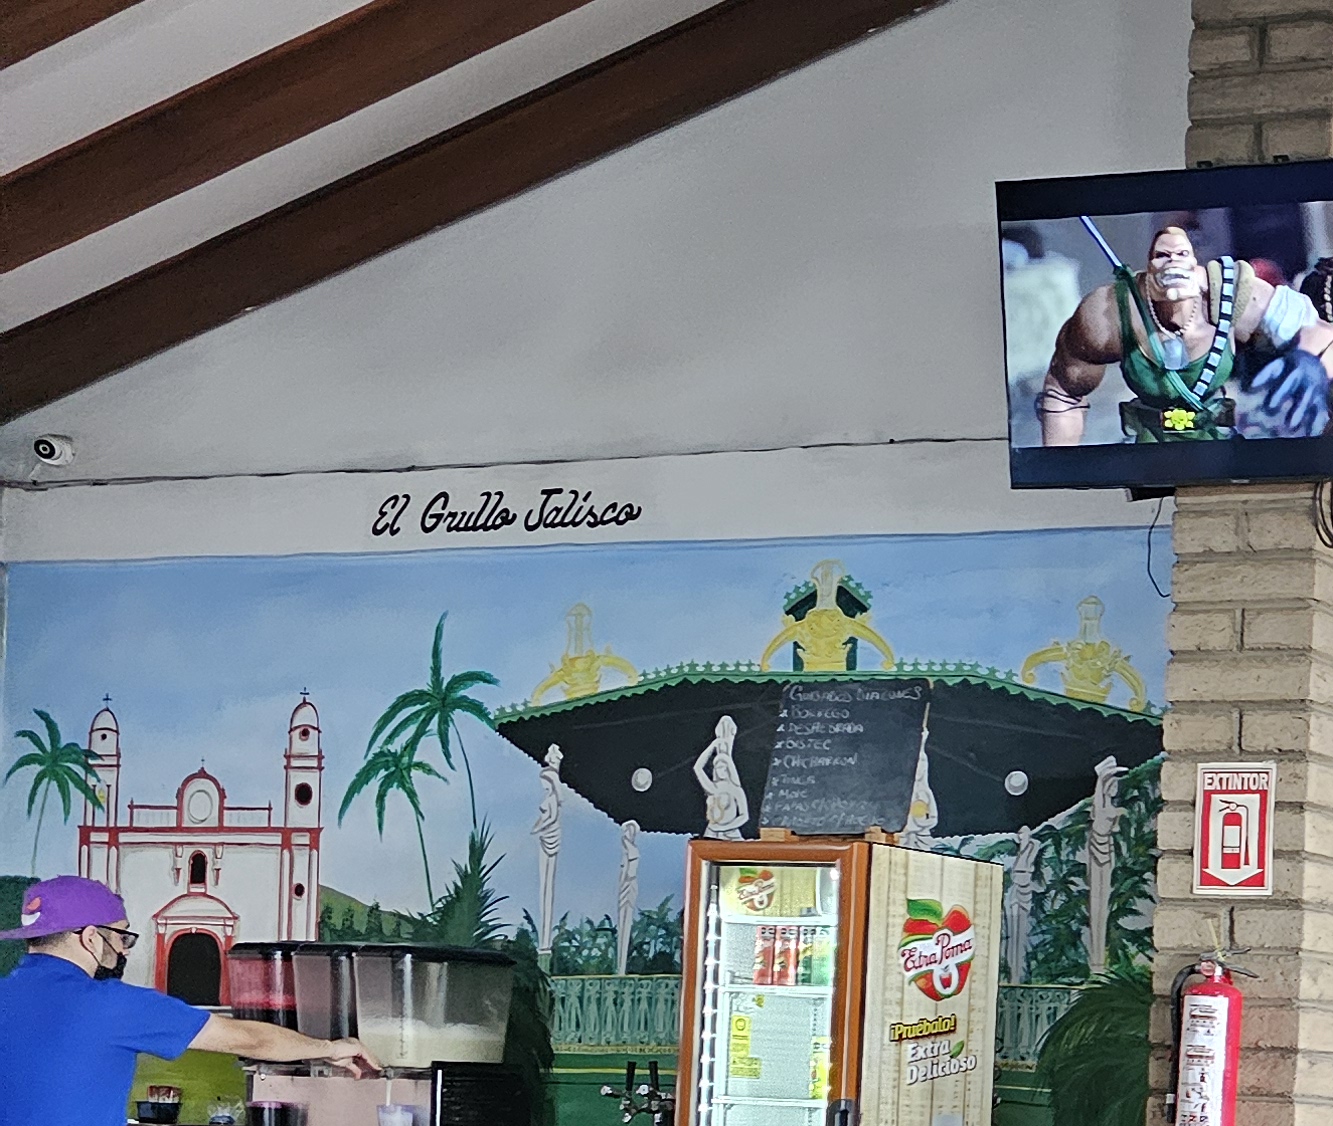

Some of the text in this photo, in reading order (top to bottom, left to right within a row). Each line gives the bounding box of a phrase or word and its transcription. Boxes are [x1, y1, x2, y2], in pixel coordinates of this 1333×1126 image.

[371, 494, 411, 536] El
[420, 491, 517, 534] Grullo
[1203, 773, 1269, 791] EXTINTOR
[908, 1040, 951, 1063] Extra
[906, 1054, 977, 1086] Delicioso
